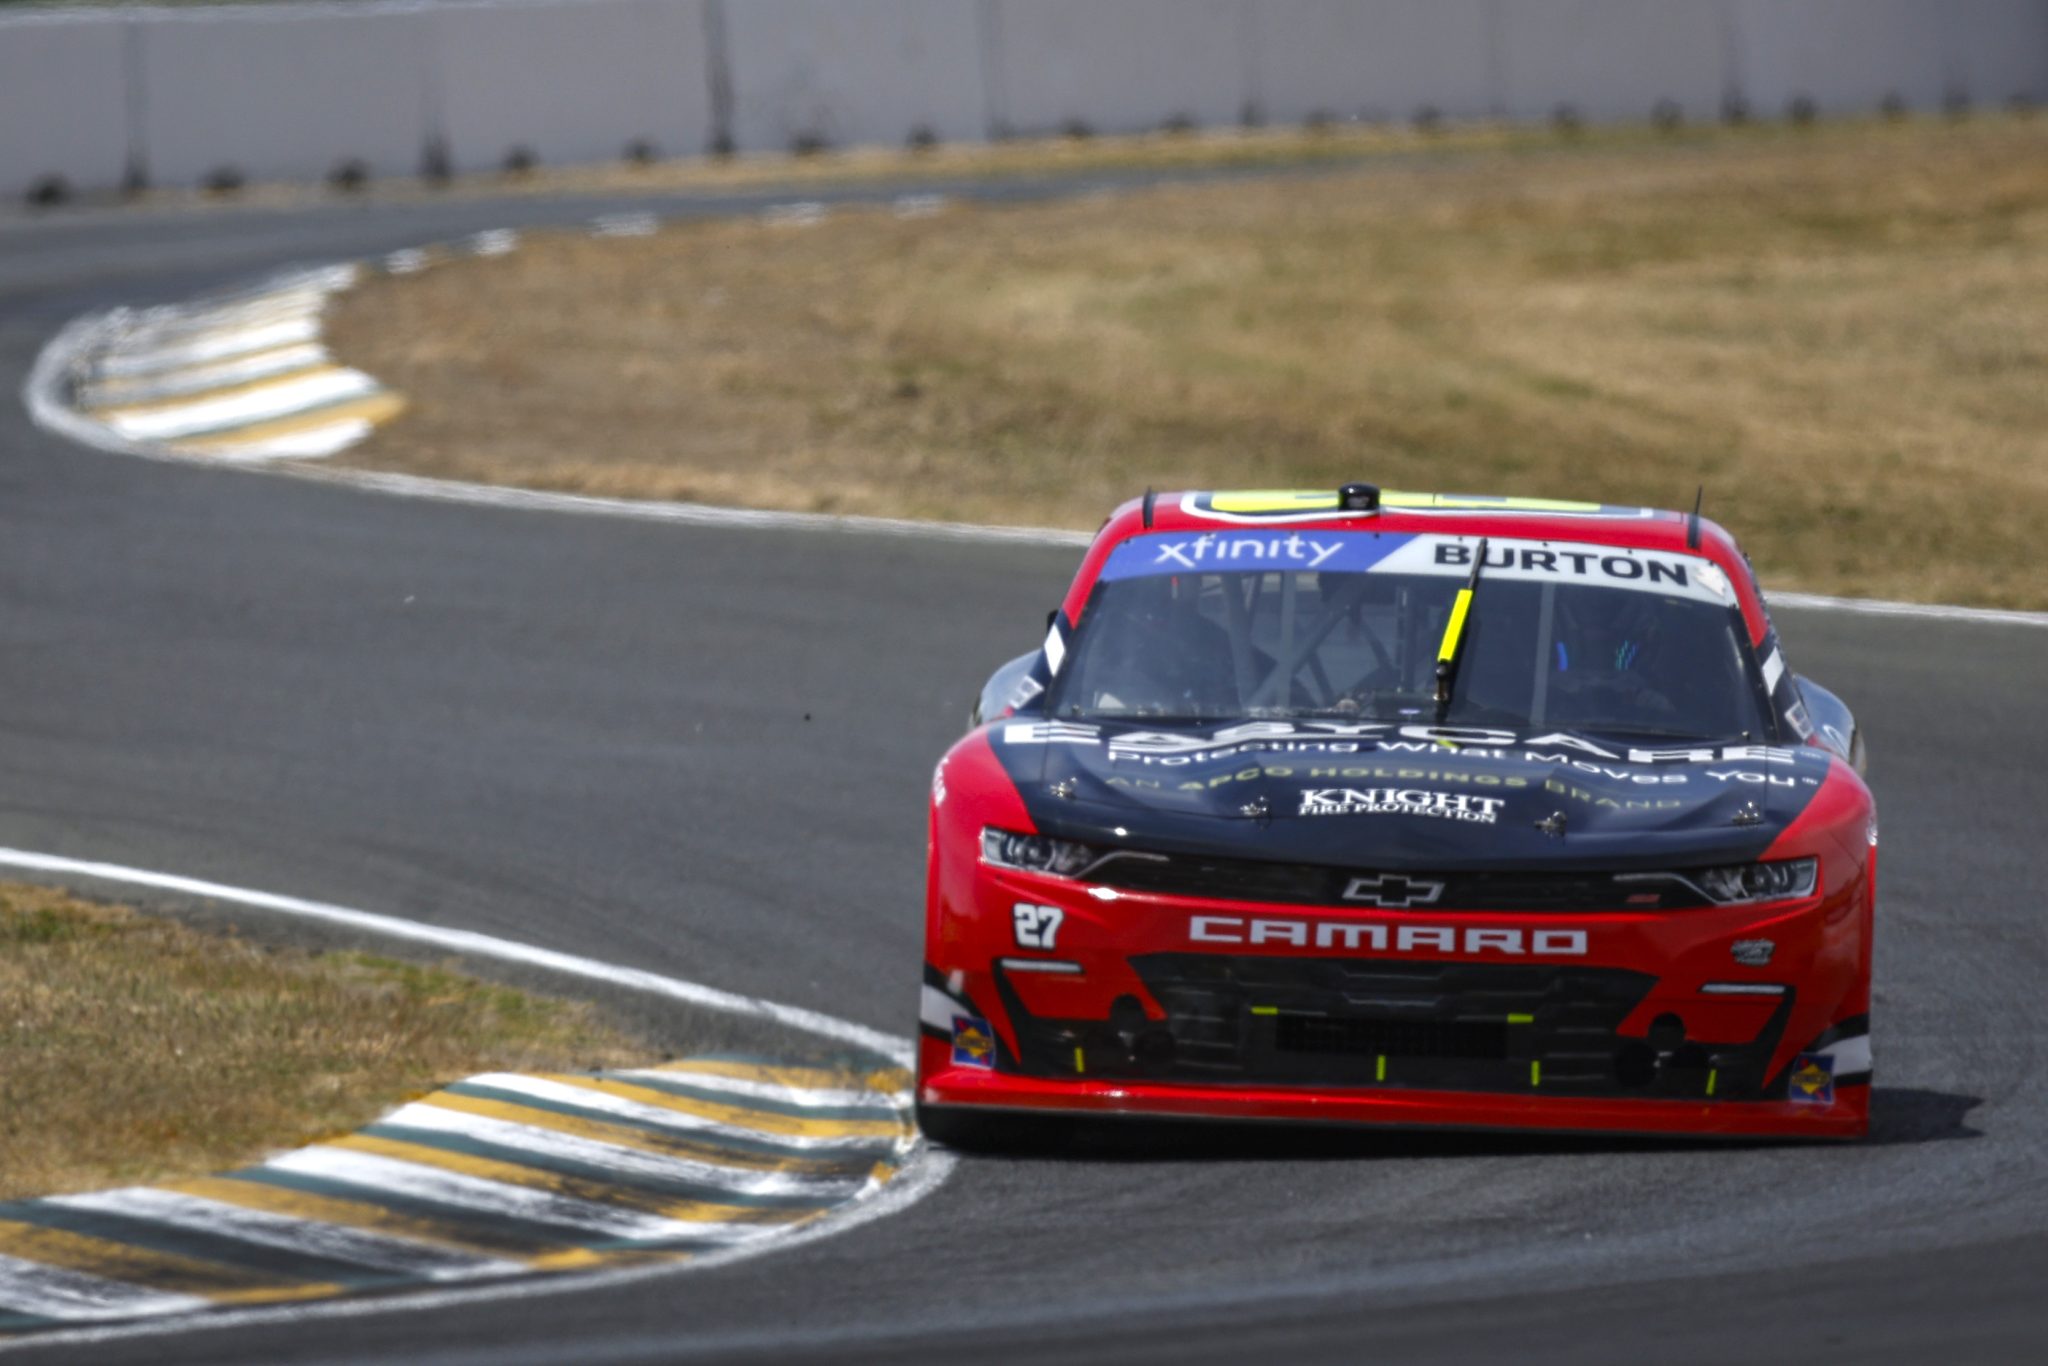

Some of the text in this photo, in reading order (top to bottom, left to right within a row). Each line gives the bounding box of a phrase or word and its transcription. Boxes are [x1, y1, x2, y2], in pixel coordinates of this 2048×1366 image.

[1154, 534, 1345, 568] xfinity
[1434, 543, 1689, 587] BURTON
[1108, 741, 1358, 766] Protecting
[1376, 741, 1504, 759] What
[1105, 776, 1160, 789] AN
[1178, 767, 1293, 790] APCO
[1310, 766, 1528, 787] HOLDINGS
[1298, 802, 1497, 824] FIRE PROTECTION
[1299, 788, 1505, 816] KNIGHT
[1013, 902, 1063, 950] 27
[1189, 915, 1588, 955] CAMARO
